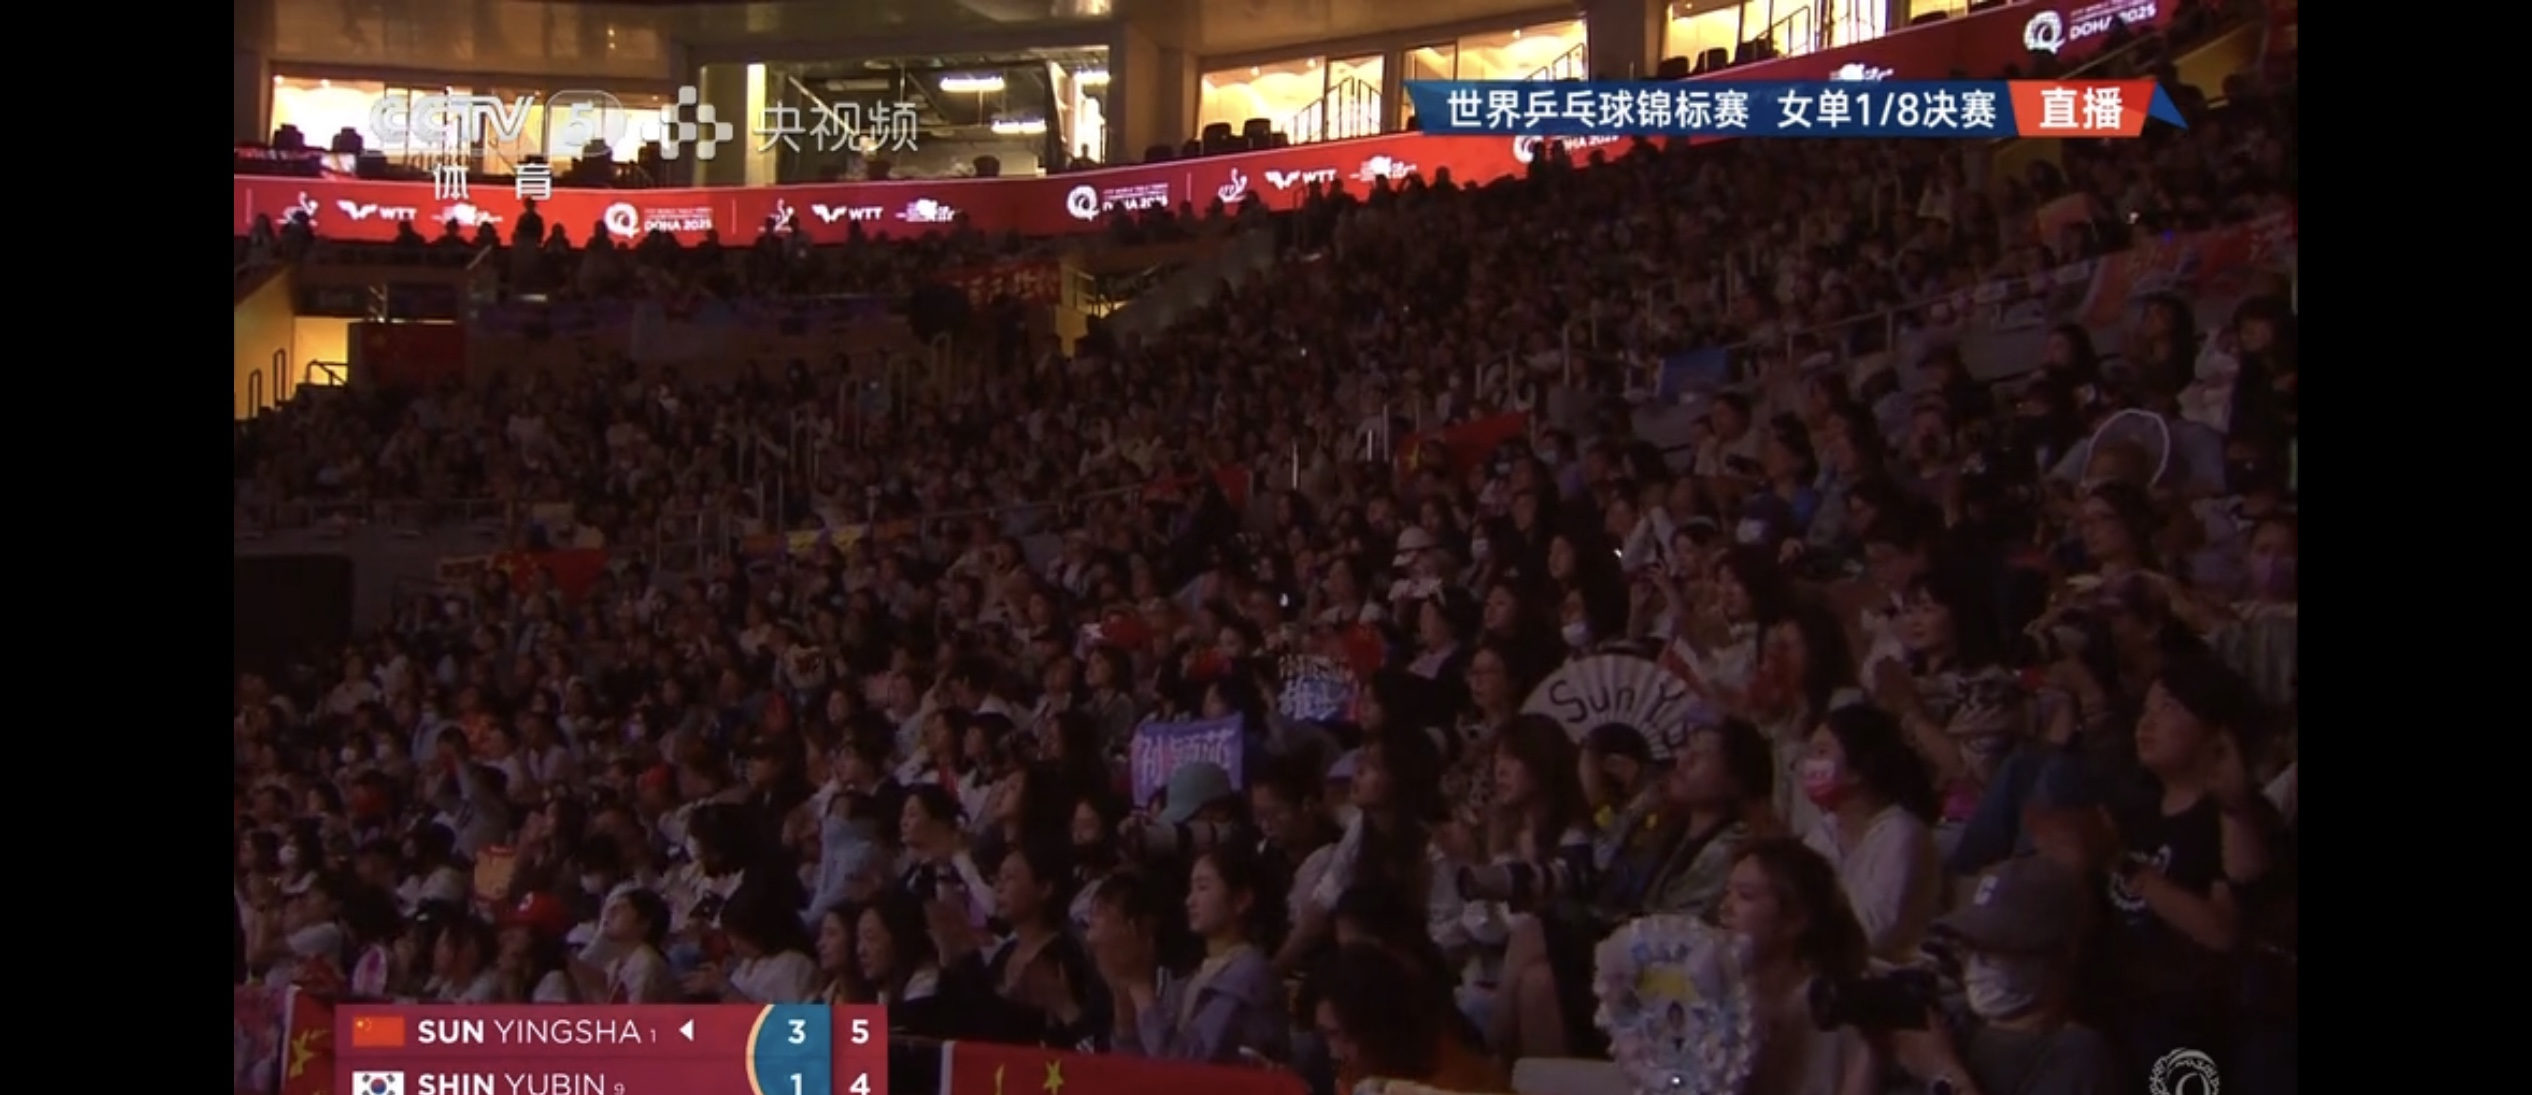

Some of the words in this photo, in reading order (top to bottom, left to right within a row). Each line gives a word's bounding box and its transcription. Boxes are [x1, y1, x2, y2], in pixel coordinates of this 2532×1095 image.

[1302, 168, 1337, 183] WTT
[380, 206, 417, 220] WTT
[849, 206, 884, 220] WTT
[1549, 679, 1635, 724] Sun
